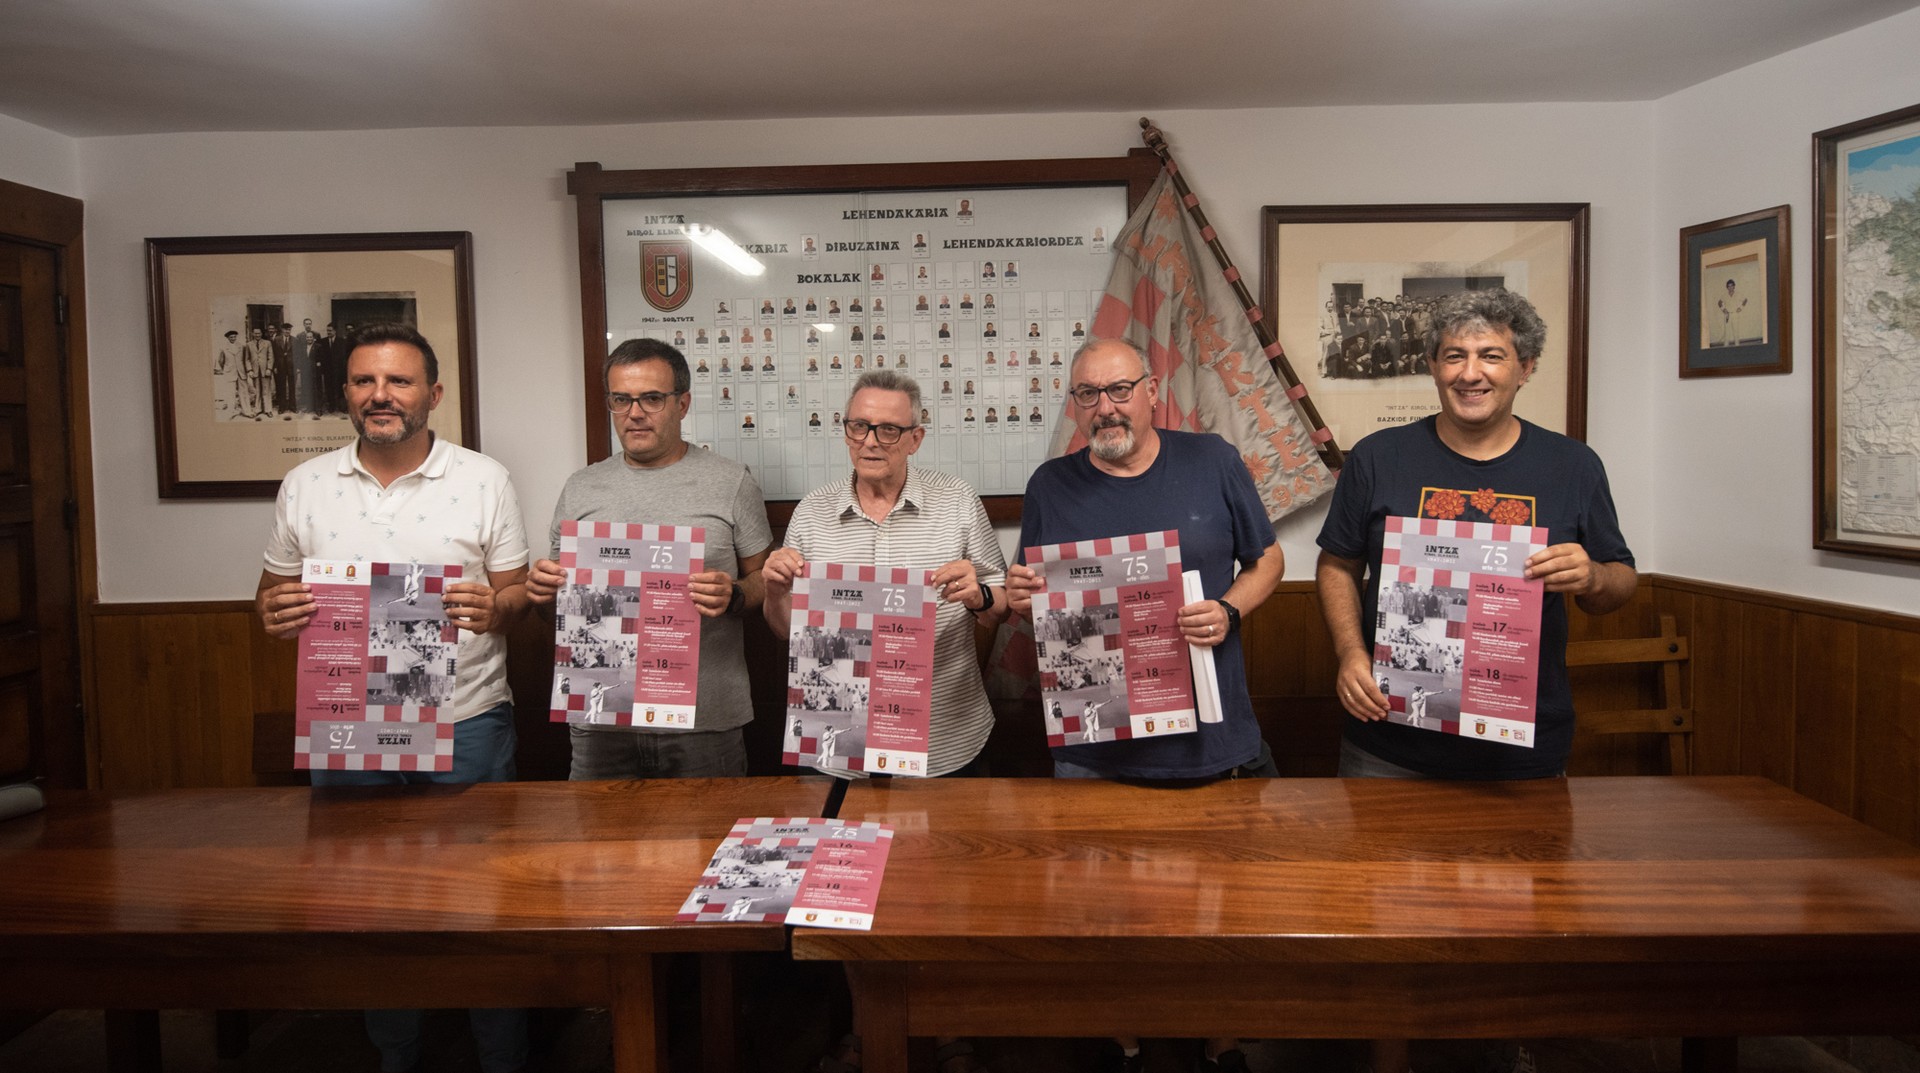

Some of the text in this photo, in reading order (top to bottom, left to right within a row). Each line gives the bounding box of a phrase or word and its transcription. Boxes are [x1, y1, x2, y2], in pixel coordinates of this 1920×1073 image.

[644, 214, 685, 224] INTZA
[842, 208, 949, 220] LEHENDAKARIA
[826, 241, 900, 252] DIRUZAINA
[943, 236, 1084, 250] LEHENDAKARIORDEA
[740, 244, 788, 254] KARIA
[797, 273, 861, 284] BOKALAK
[649, 545, 673, 563] 75
[1425, 545, 1459, 555] INTZA
[1480, 545, 1508, 565] 75
[1070, 566, 1102, 575] INTZA
[1122, 556, 1148, 576] 75
[660, 580, 671, 589] 16
[1491, 583, 1505, 594] 16
[832, 589, 863, 598] INTZA
[882, 588, 906, 607] 75
[1138, 590, 1151, 600] 16
[662, 616, 673, 624] 17
[334, 621, 346, 631] 18
[892, 623, 904, 633] 16
[1145, 624, 1157, 634] 17
[1493, 622, 1507, 632] 17
[657, 659, 668, 669] 18
[894, 660, 906, 669] 17
[328, 667, 341, 676] 17
[1146, 667, 1159, 678] 18
[1486, 668, 1500, 679] 18
[331, 704, 344, 714] 16
[888, 703, 899, 714] 18
[329, 731, 356, 749] 75
[832, 826, 857, 836] 75
